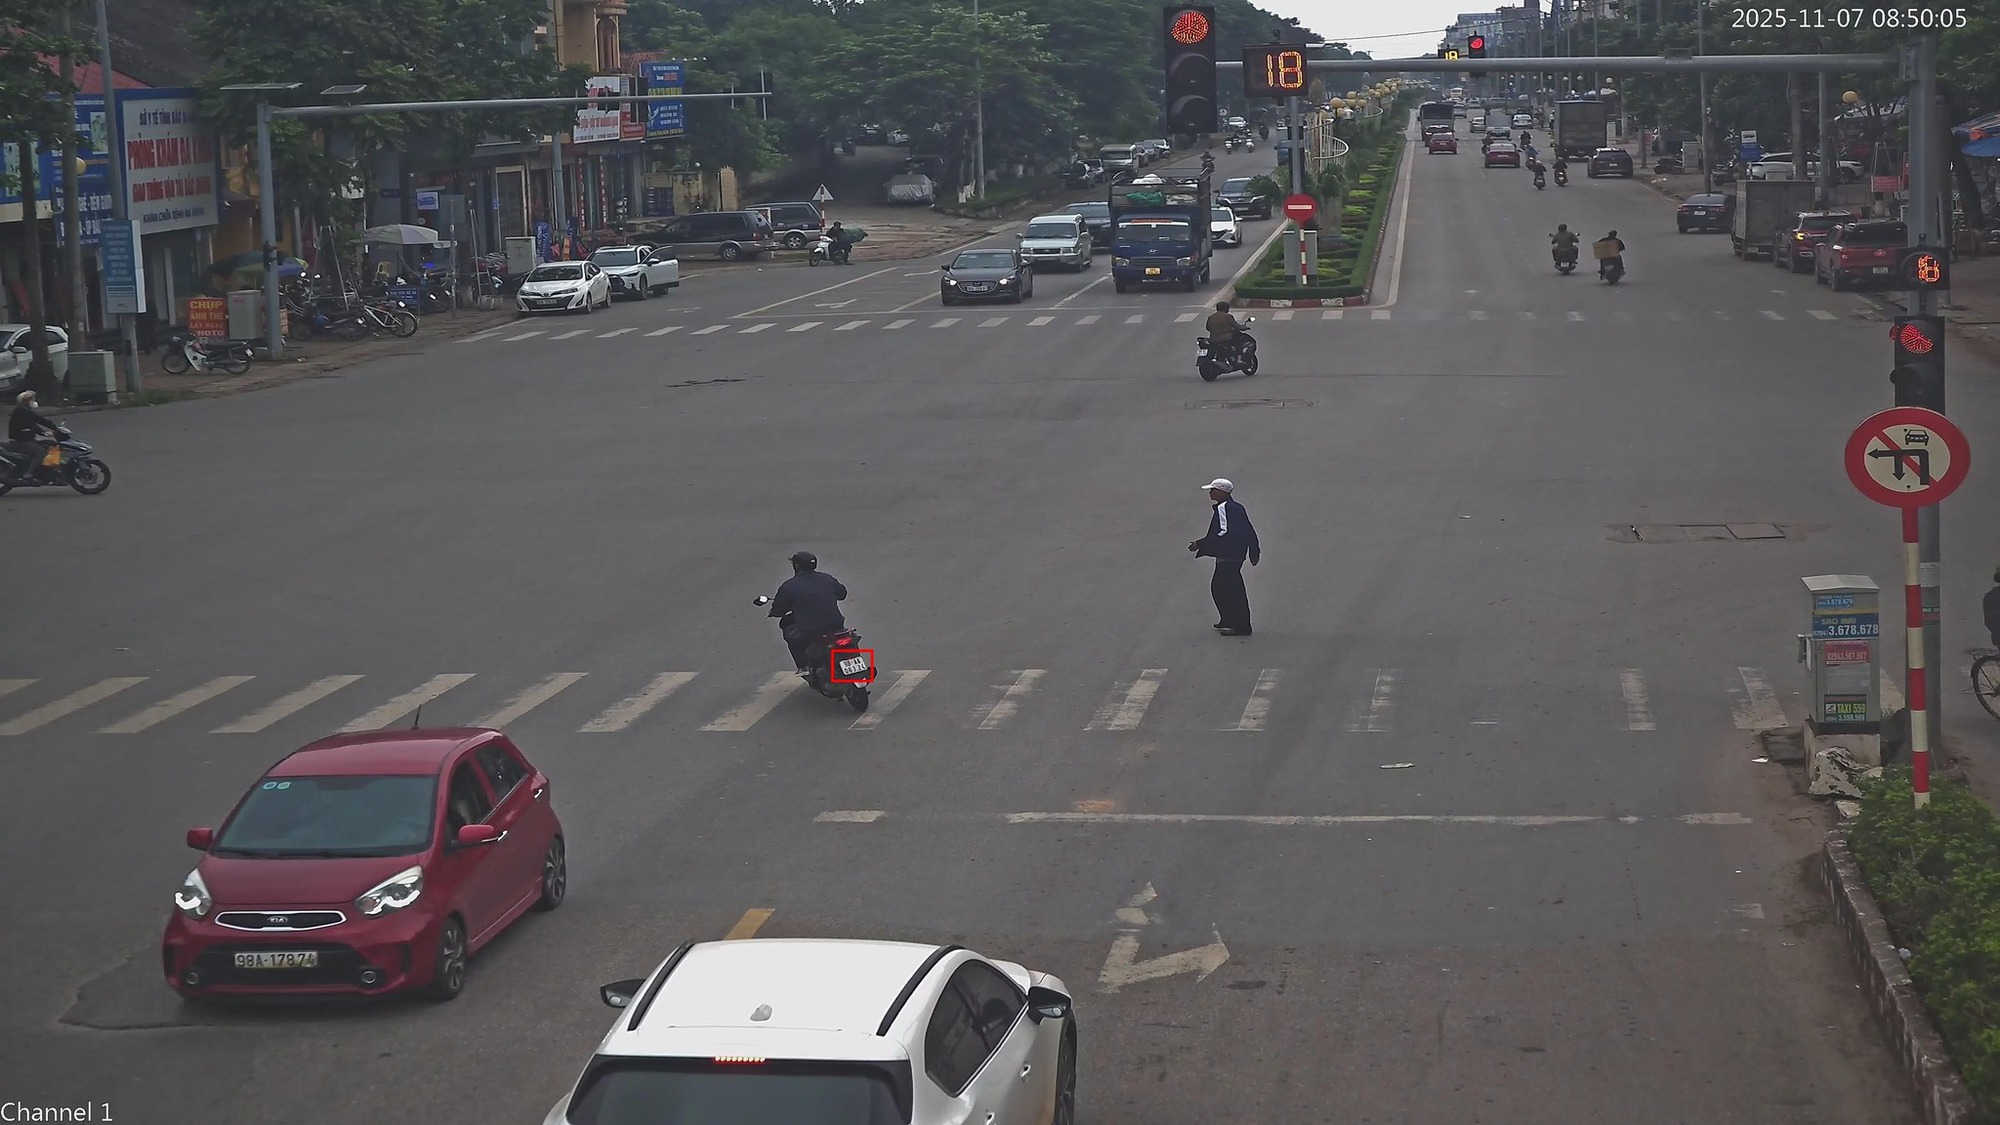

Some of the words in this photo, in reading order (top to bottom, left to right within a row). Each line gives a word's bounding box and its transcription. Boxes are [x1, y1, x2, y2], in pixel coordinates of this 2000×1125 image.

[1266, 51, 1303, 88] 18
[1828, 624, 1879, 636] 3.678.678
[1836, 703, 1852, 714] TAXI
[1852, 703, 1866, 713] 559
